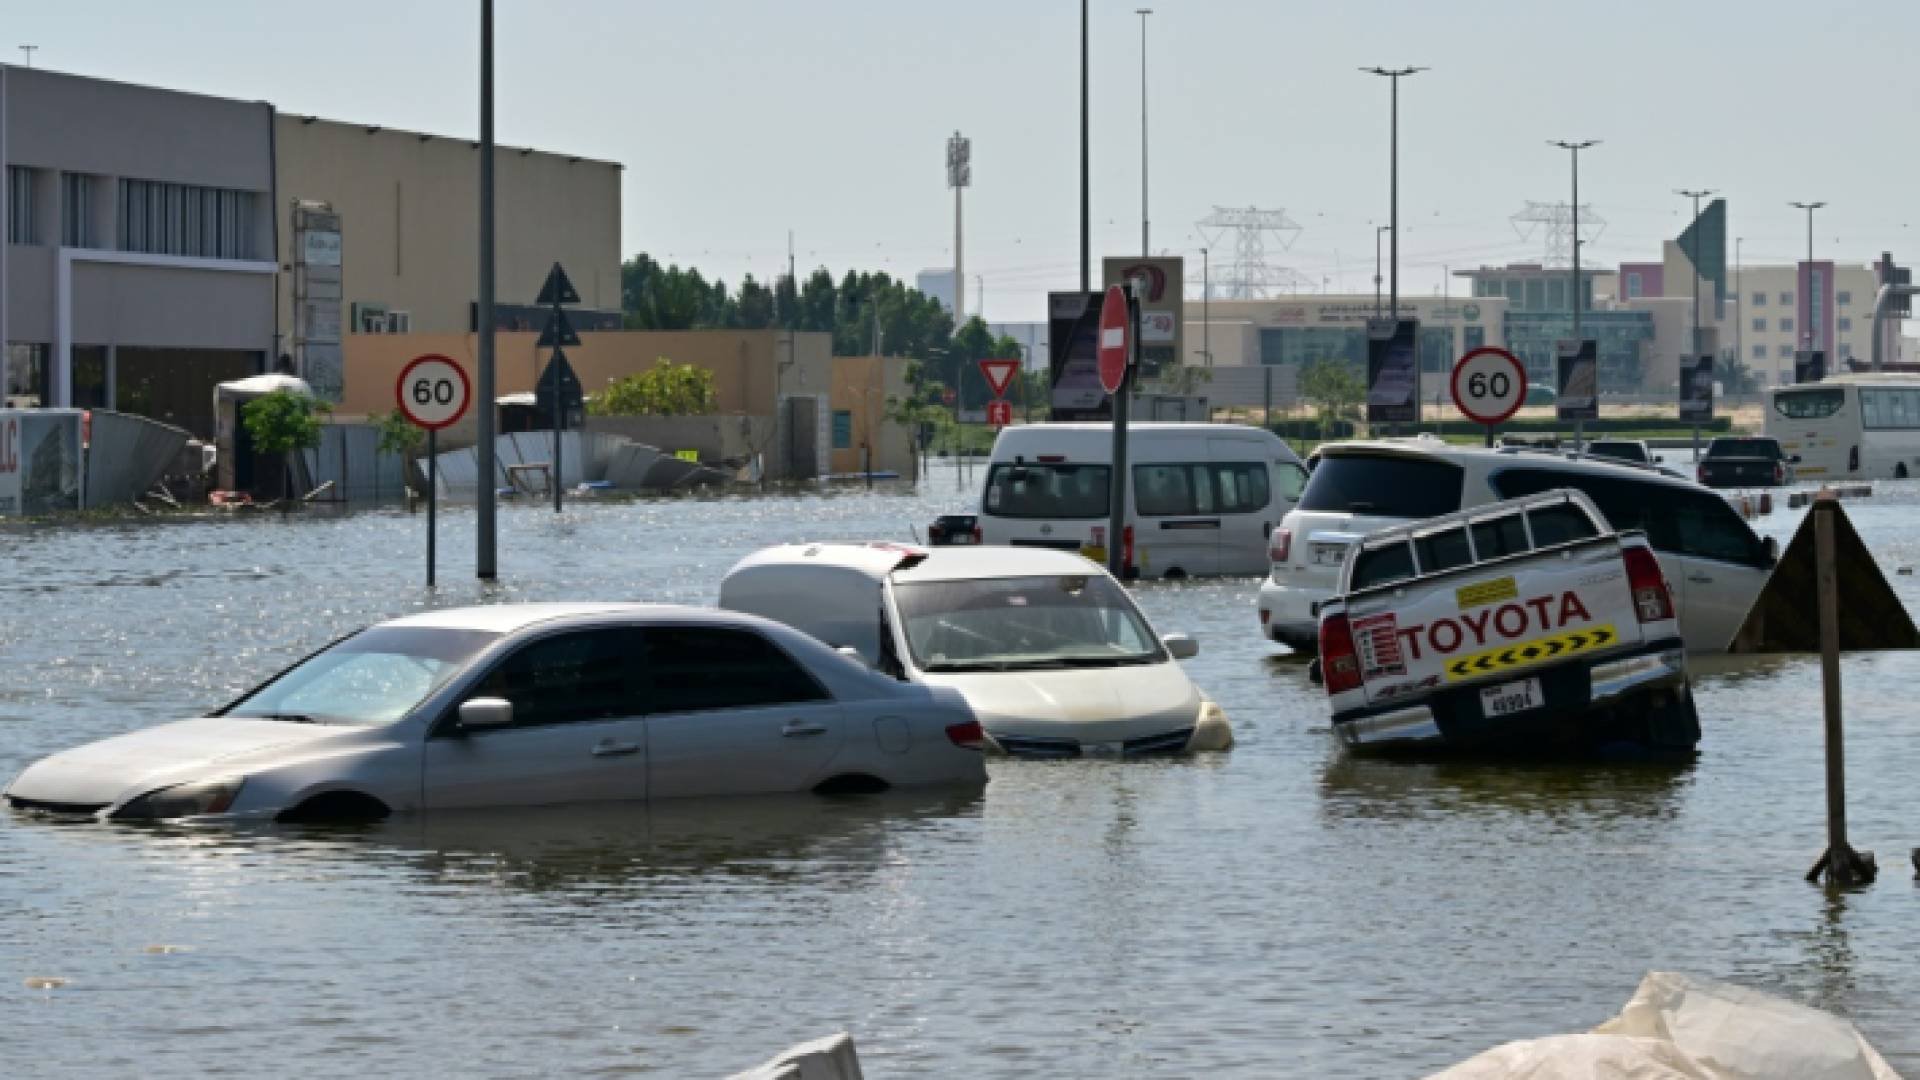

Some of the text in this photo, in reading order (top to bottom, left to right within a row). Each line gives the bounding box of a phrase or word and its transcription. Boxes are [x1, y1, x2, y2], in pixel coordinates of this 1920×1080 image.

[412, 378, 454, 405] 60
[1468, 372, 1510, 398] 60
[1396, 591, 1591, 659] TOYOTA
